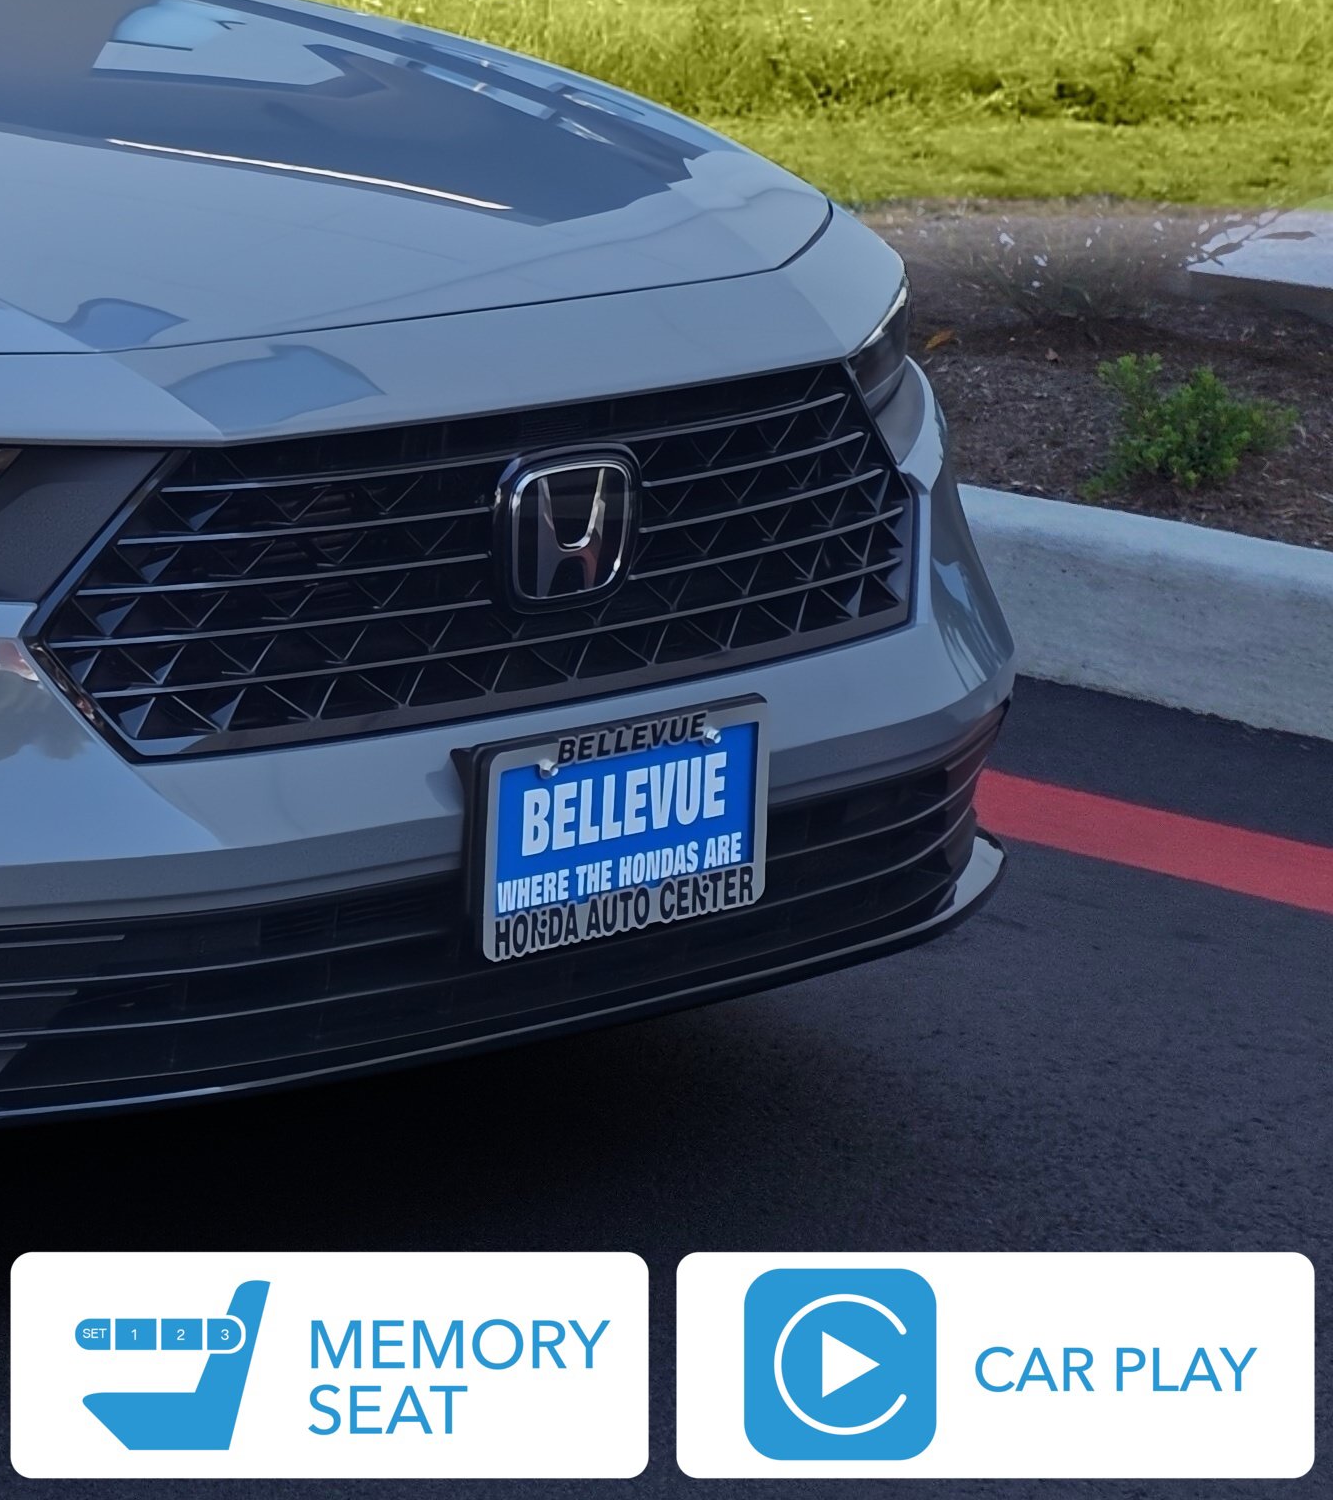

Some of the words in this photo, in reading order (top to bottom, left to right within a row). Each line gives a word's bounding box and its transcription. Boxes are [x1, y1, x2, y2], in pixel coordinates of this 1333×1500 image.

[557, 712, 707, 764] BELLEVUE
[521, 752, 727, 857] BELLEVUE
[494, 903, 580, 959] HONDA
[585, 886, 650, 938] AUTO
[659, 865, 753, 920] CENTER
[497, 868, 570, 914] WHERE
[575, 859, 613, 897] THE
[618, 840, 699, 888] HONDAS
[703, 831, 742, 869] ARE
